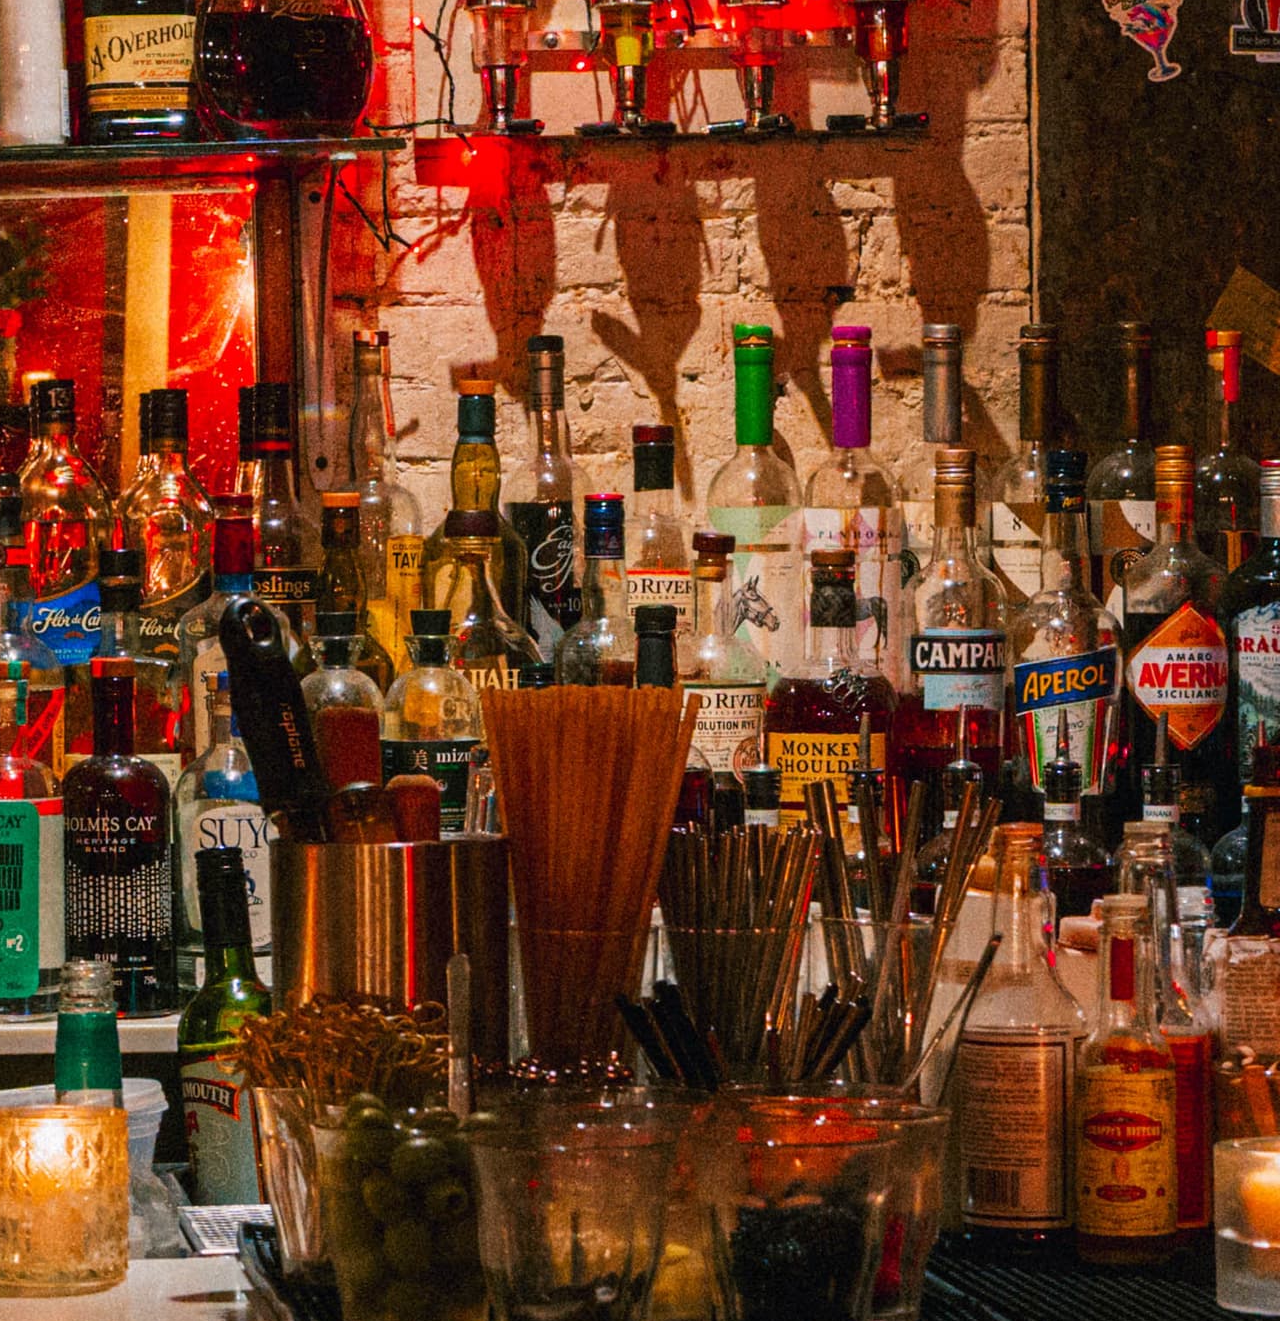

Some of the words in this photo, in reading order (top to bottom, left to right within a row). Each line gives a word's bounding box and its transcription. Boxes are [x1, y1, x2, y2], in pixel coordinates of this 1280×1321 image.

[393, 553, 424, 569] TAYL
[254, 579, 311, 596] oslings
[33, 606, 71, 632] Flor
[916, 641, 1005, 668] CAMPAR
[1167, 652, 1213, 661] AMARO
[1139, 663, 1228, 689] AVERNA
[1023, 666, 1108, 703] APEROL
[716, 693, 764, 709] RIVER
[1157, 689, 1220, 699] SICILIANO
[697, 720, 739, 730] OLUTION
[742, 720, 756, 729] RYE
[64, 817, 120, 832] HOLMES
[125, 817, 153, 831] CAY
